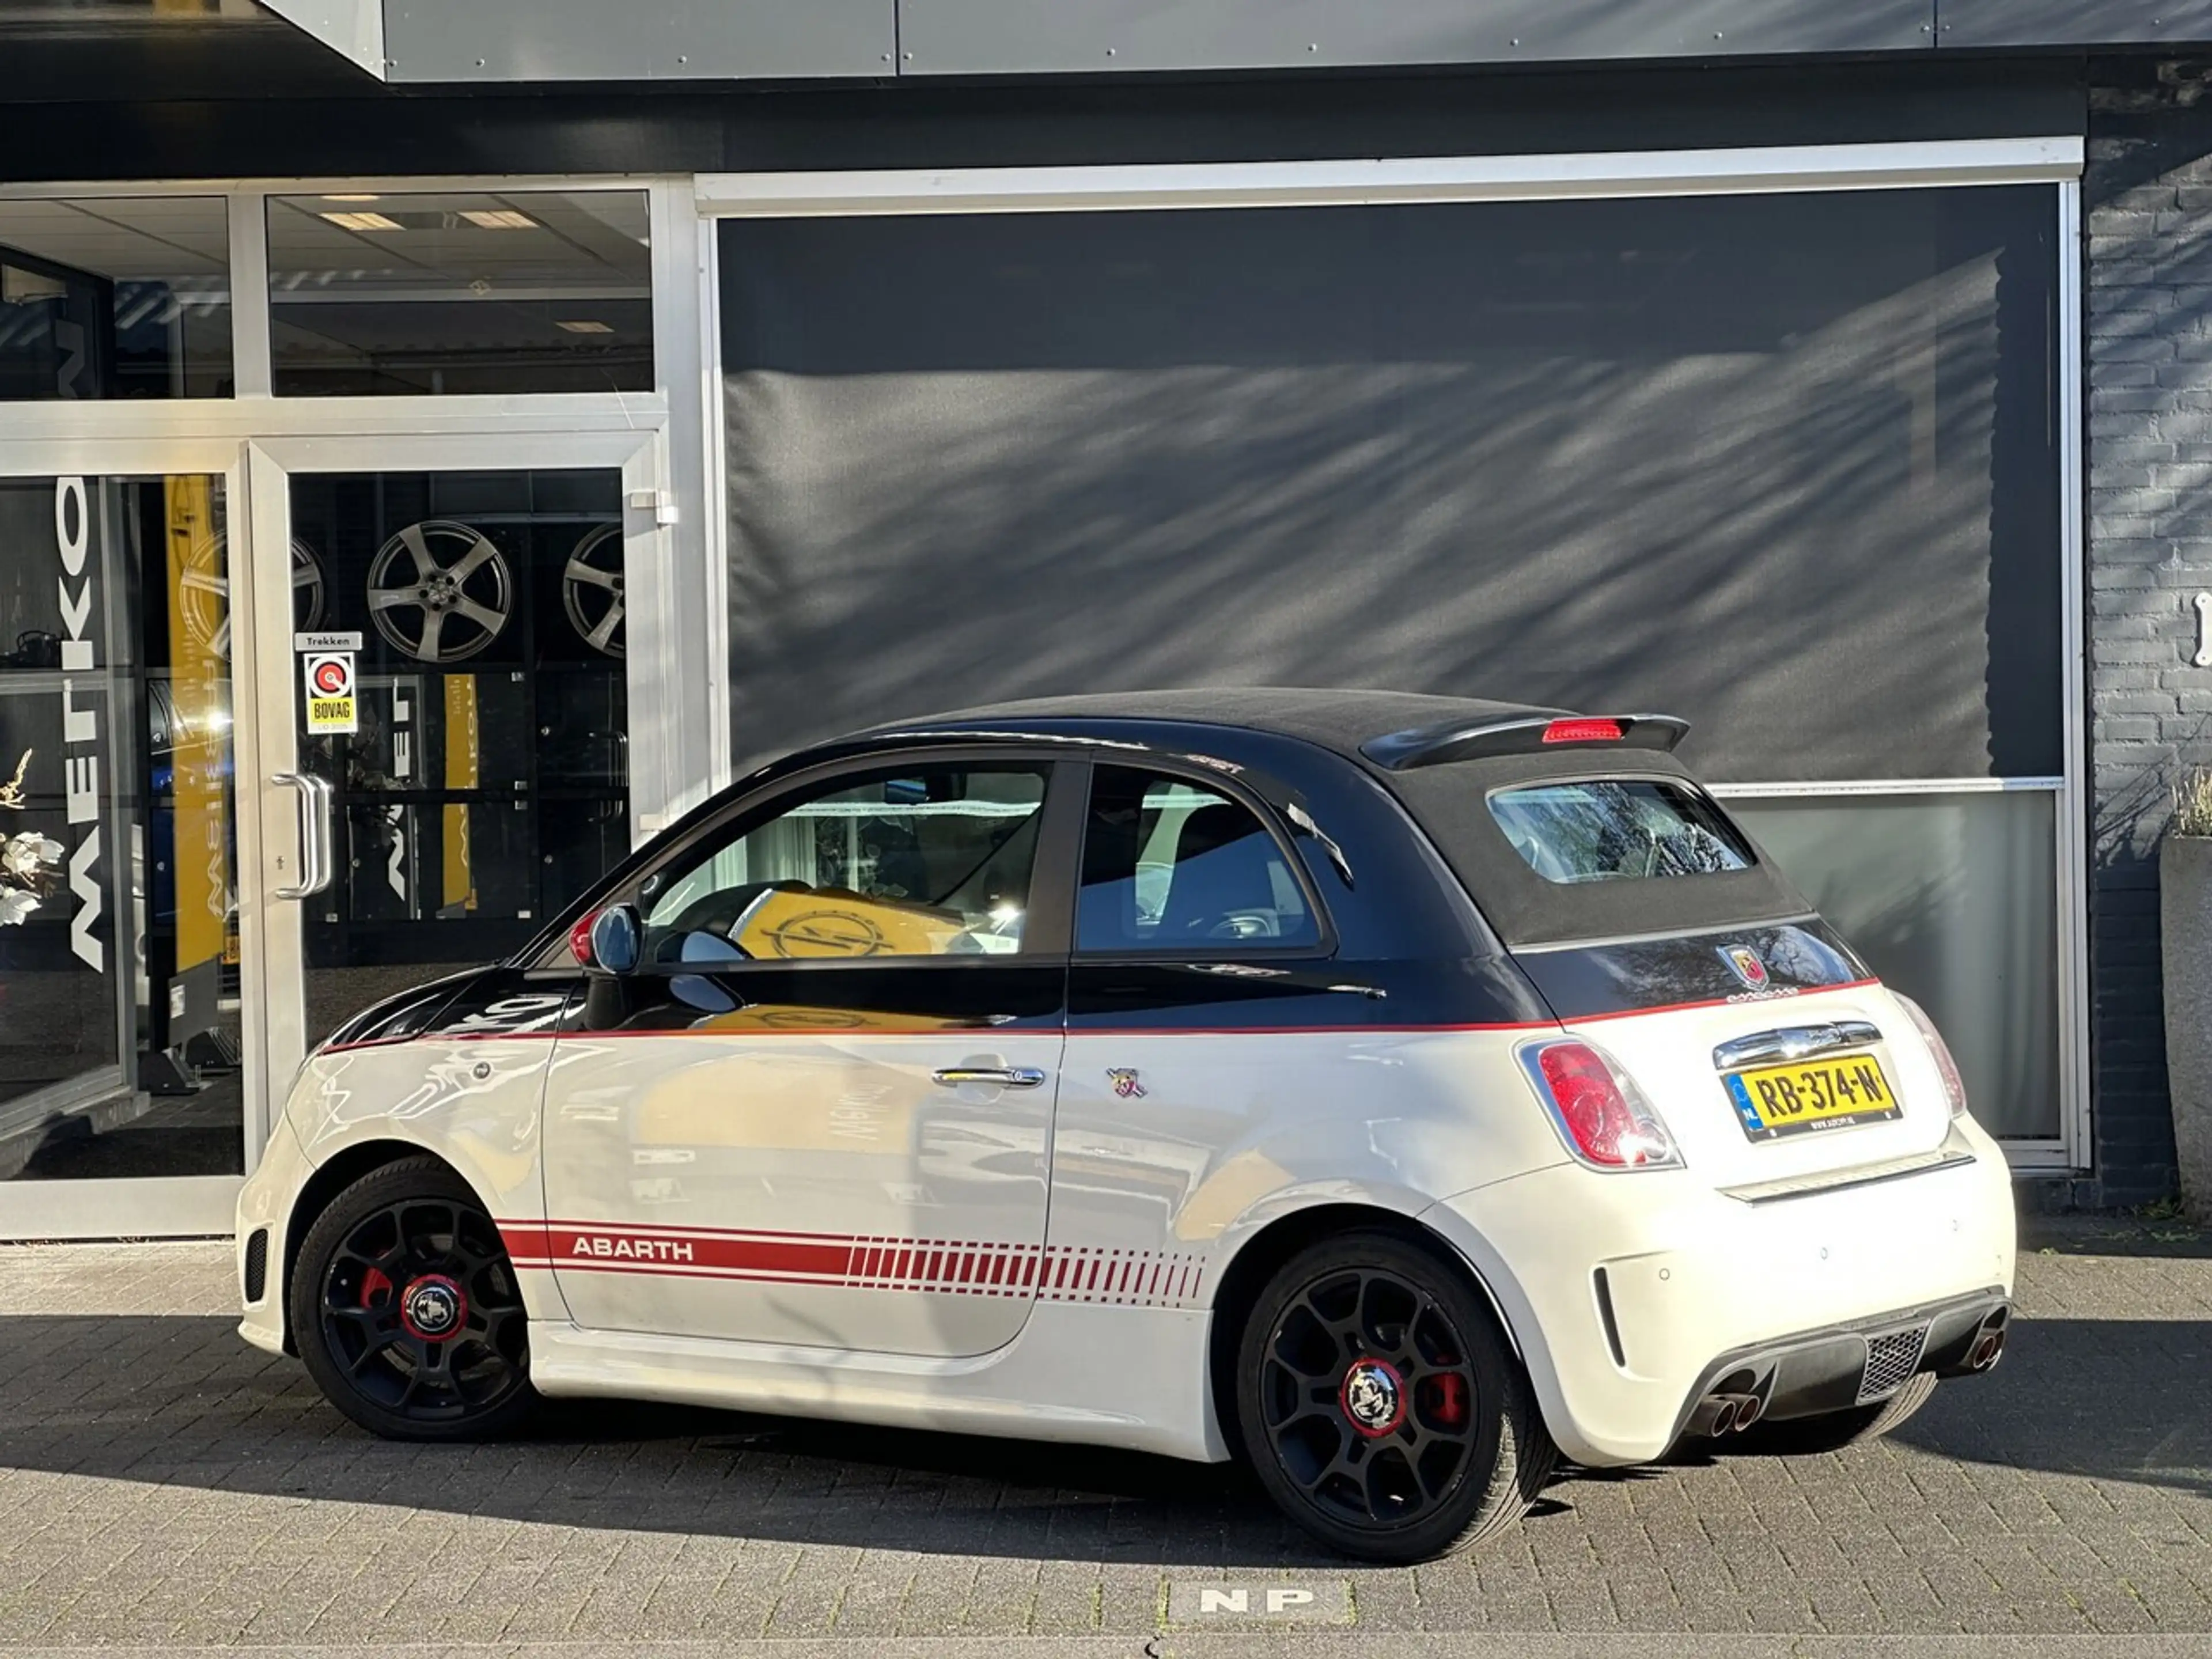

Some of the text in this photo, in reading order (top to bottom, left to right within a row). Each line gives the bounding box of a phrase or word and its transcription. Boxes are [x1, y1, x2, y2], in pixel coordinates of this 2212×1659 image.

[306, 637, 350, 646] Trekken
[314, 701, 350, 719] BOVAG
[1755, 1065, 1884, 1118] RB-374-N
[1743, 1107, 1759, 1120] NL
[573, 1237, 693, 1261] ABARTH
